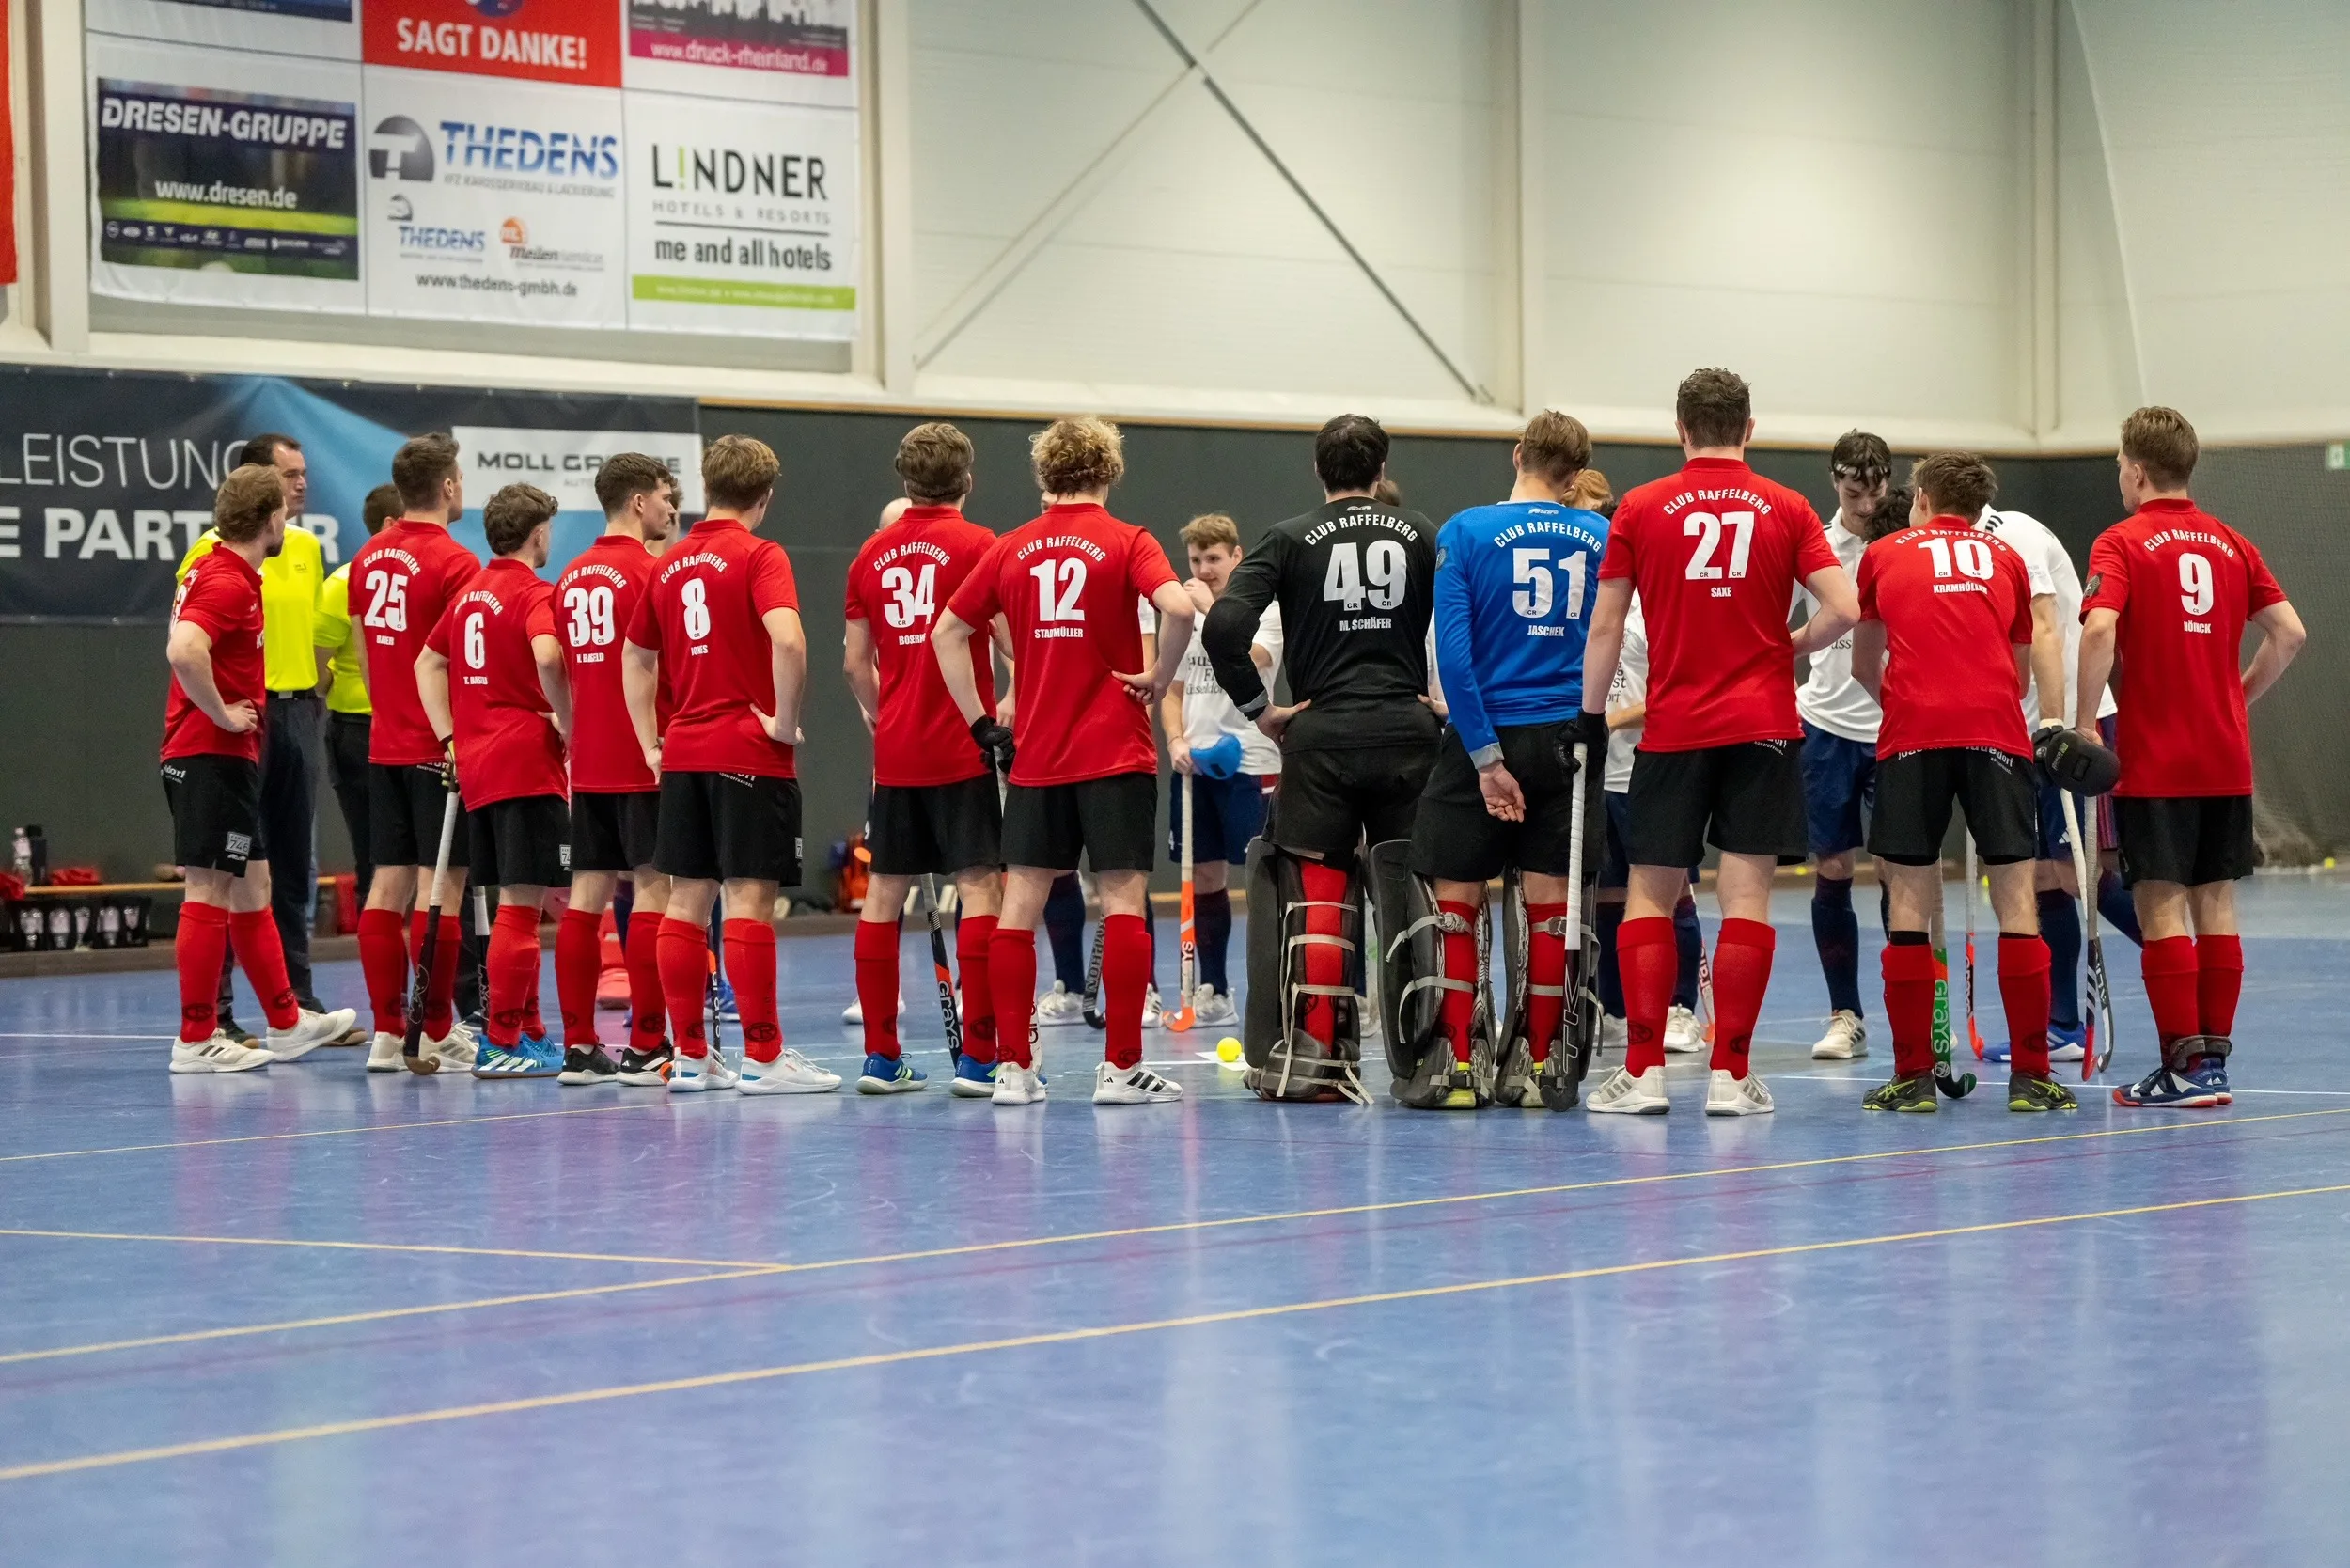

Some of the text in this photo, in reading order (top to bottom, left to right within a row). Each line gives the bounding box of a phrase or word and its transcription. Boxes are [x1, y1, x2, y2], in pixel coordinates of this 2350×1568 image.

[397, 18, 587, 70] SAGT DANKE!
[650, 39, 828, 72] www.druck-rheinland.de
[102, 98, 346, 148] DRESEN-GRUPPE
[440, 120, 618, 180] THEDENS
[155, 180, 298, 209] www.dresen.de
[653, 200, 724, 217] HOTELS
[757, 207, 831, 225] RESORTS
[399, 226, 486, 252] THEDENS
[655, 237, 831, 270] me and all hotels
[415, 273, 577, 297] www.thedens-gmbh.de
[478, 452, 556, 472] MOLL
[1663, 488, 1772, 515] CLUB RAFFELBERG
[44, 508, 340, 564] PARTR
[1304, 513, 1418, 546] CLUB RAFFELBERG
[1493, 521, 1602, 553] CLUB RAFFELBERG
[1683, 511, 1755, 580] 27
[1895, 529, 1926, 545] CLUB
[2144, 529, 2234, 558] CLUB RAFFELBERG
[363, 549, 382, 569] CLUB
[874, 541, 951, 572] CLUB RAFFELBERG
[1017, 535, 1106, 563] CLUB RAFFELBERG
[1917, 537, 1994, 580] 10
[560, 565, 627, 591] CLUB RAFFELBERG
[660, 552, 728, 584] CLUB RAFFELBERG
[1324, 539, 1407, 611] 49
[1512, 548, 1587, 619] 51
[2178, 552, 2214, 616] 9
[364, 570, 408, 632] 25
[881, 563, 936, 629] 34
[1029, 557, 1088, 622] 12
[1711, 587, 1731, 597] SAXE
[564, 586, 615, 648] 39
[682, 577, 711, 640] 8
[1351, 617, 1392, 630] SCHÄFER
[464, 612, 485, 669] 6
